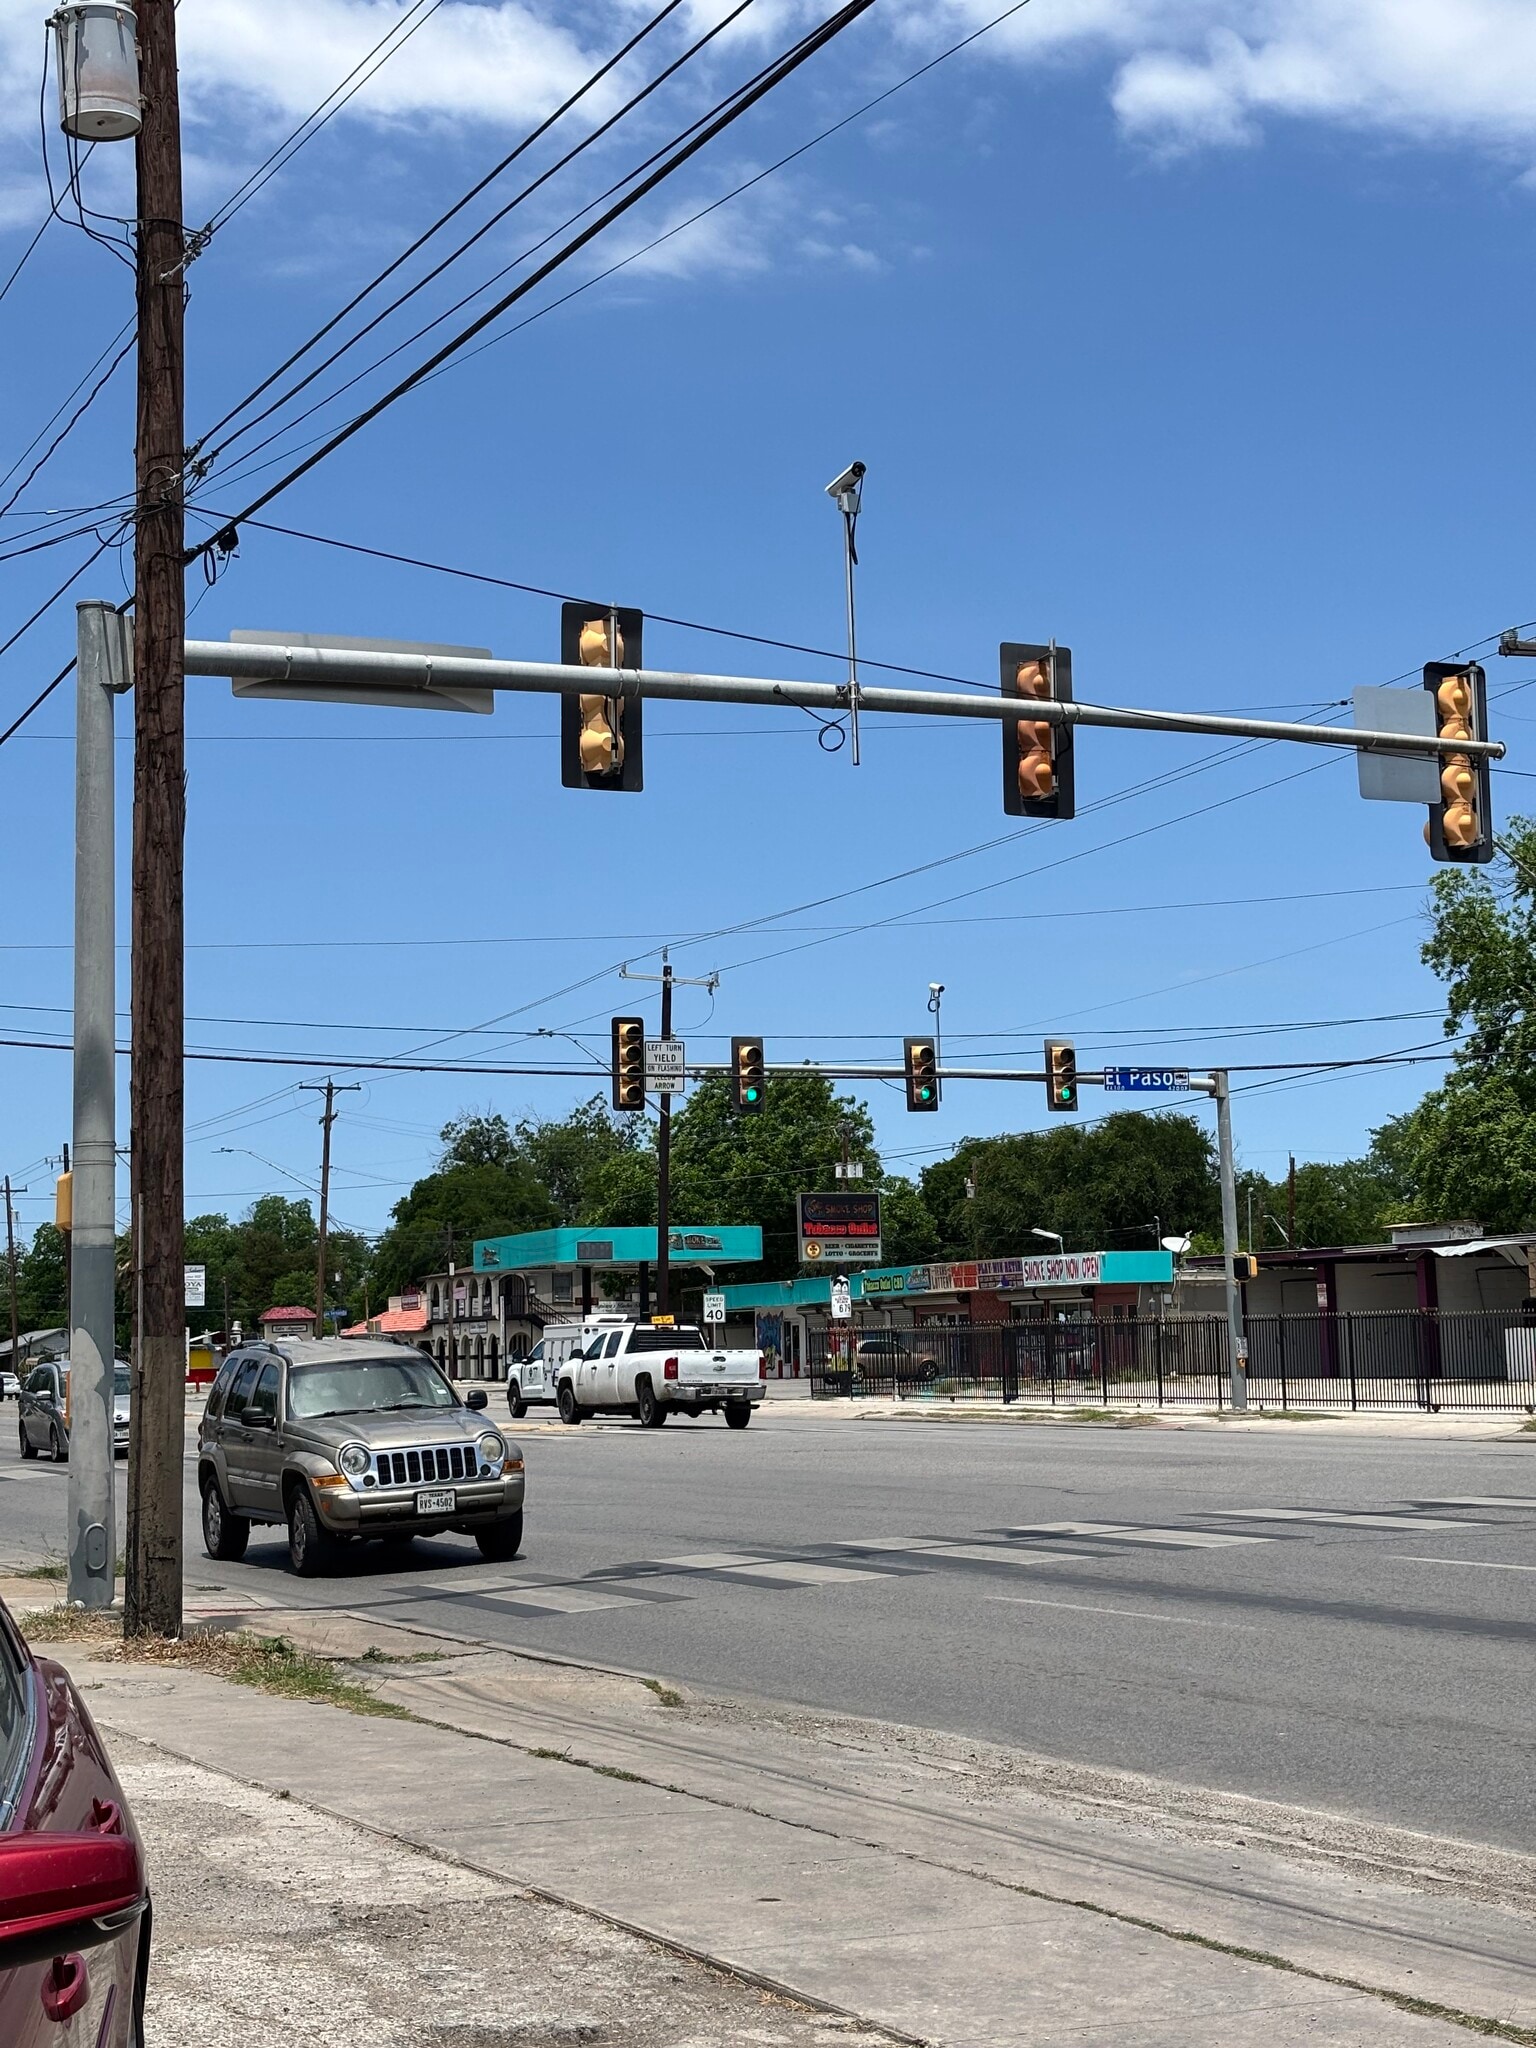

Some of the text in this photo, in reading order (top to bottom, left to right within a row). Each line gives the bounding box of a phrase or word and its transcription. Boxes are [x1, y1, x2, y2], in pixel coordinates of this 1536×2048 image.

[654, 1054, 676, 1062] YIELD
[1105, 1067, 1174, 1086] El Paso
[825, 1204, 851, 1214] SMOKE
[853, 1204, 873, 1214] SHOP
[803, 1222, 878, 1235] Tobacco Outlet
[1024, 1260, 1046, 1282] SMOKE
[1047, 1259, 1064, 1281] SHOP
[1065, 1258, 1080, 1280] NOW
[1082, 1256, 1099, 1278] OPEN
[706, 1309, 723, 1321] 40
